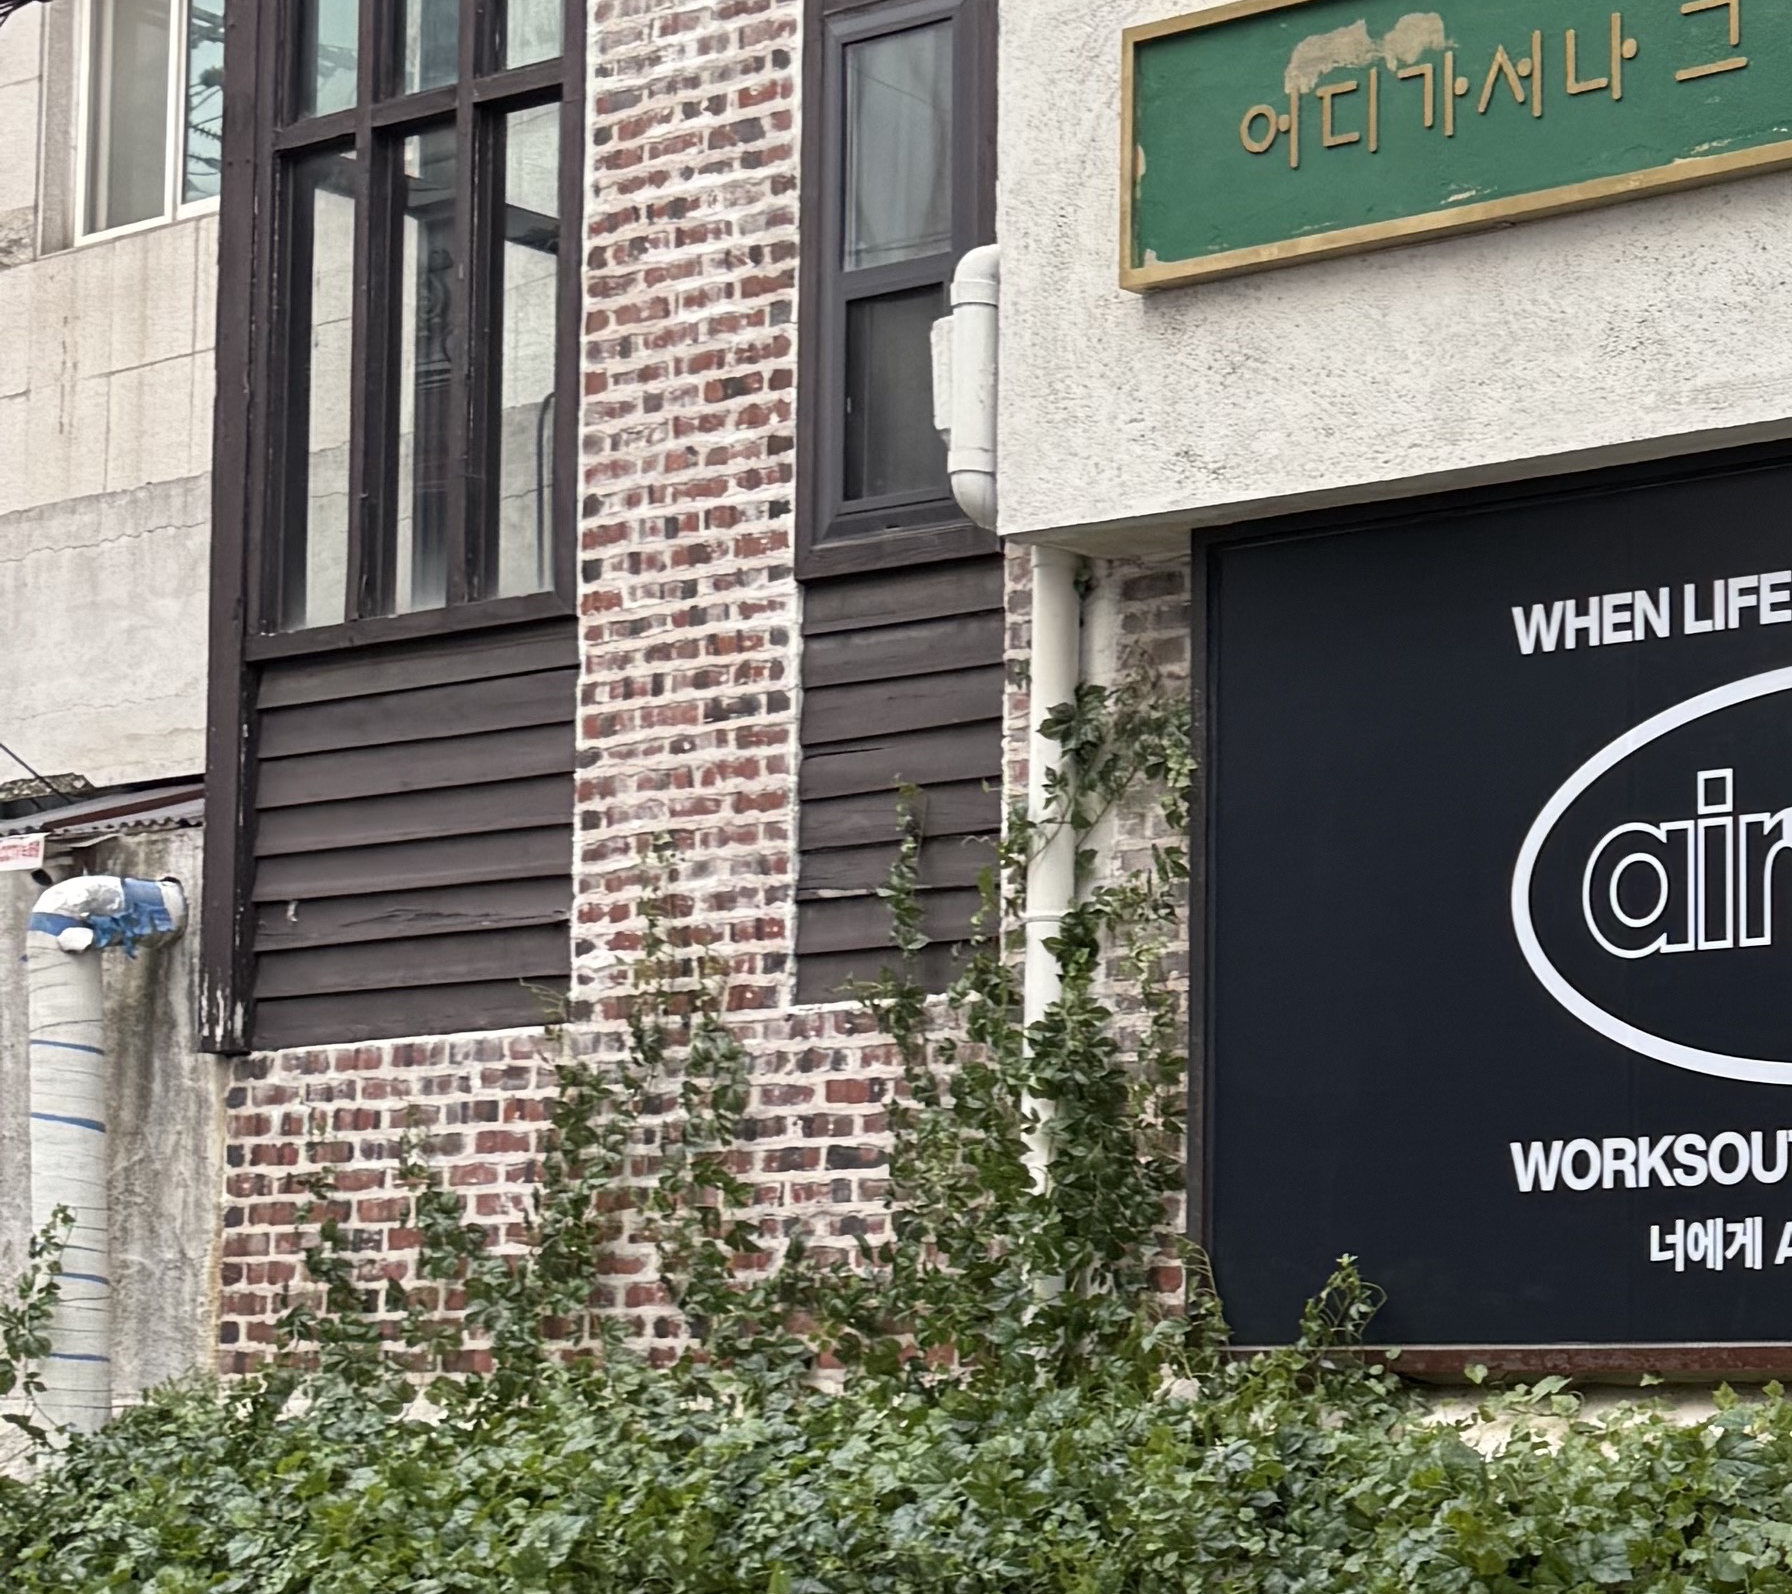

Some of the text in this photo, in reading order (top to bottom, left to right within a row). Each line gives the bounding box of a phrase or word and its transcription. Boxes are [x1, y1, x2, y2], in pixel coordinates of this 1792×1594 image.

[1239, 12, 1637, 168] 어디가서나
[1512, 587, 1670, 654] WHEN
[1684, 570, 1792, 634] LIFE
[1650, 1217, 1763, 1271] 너에게
